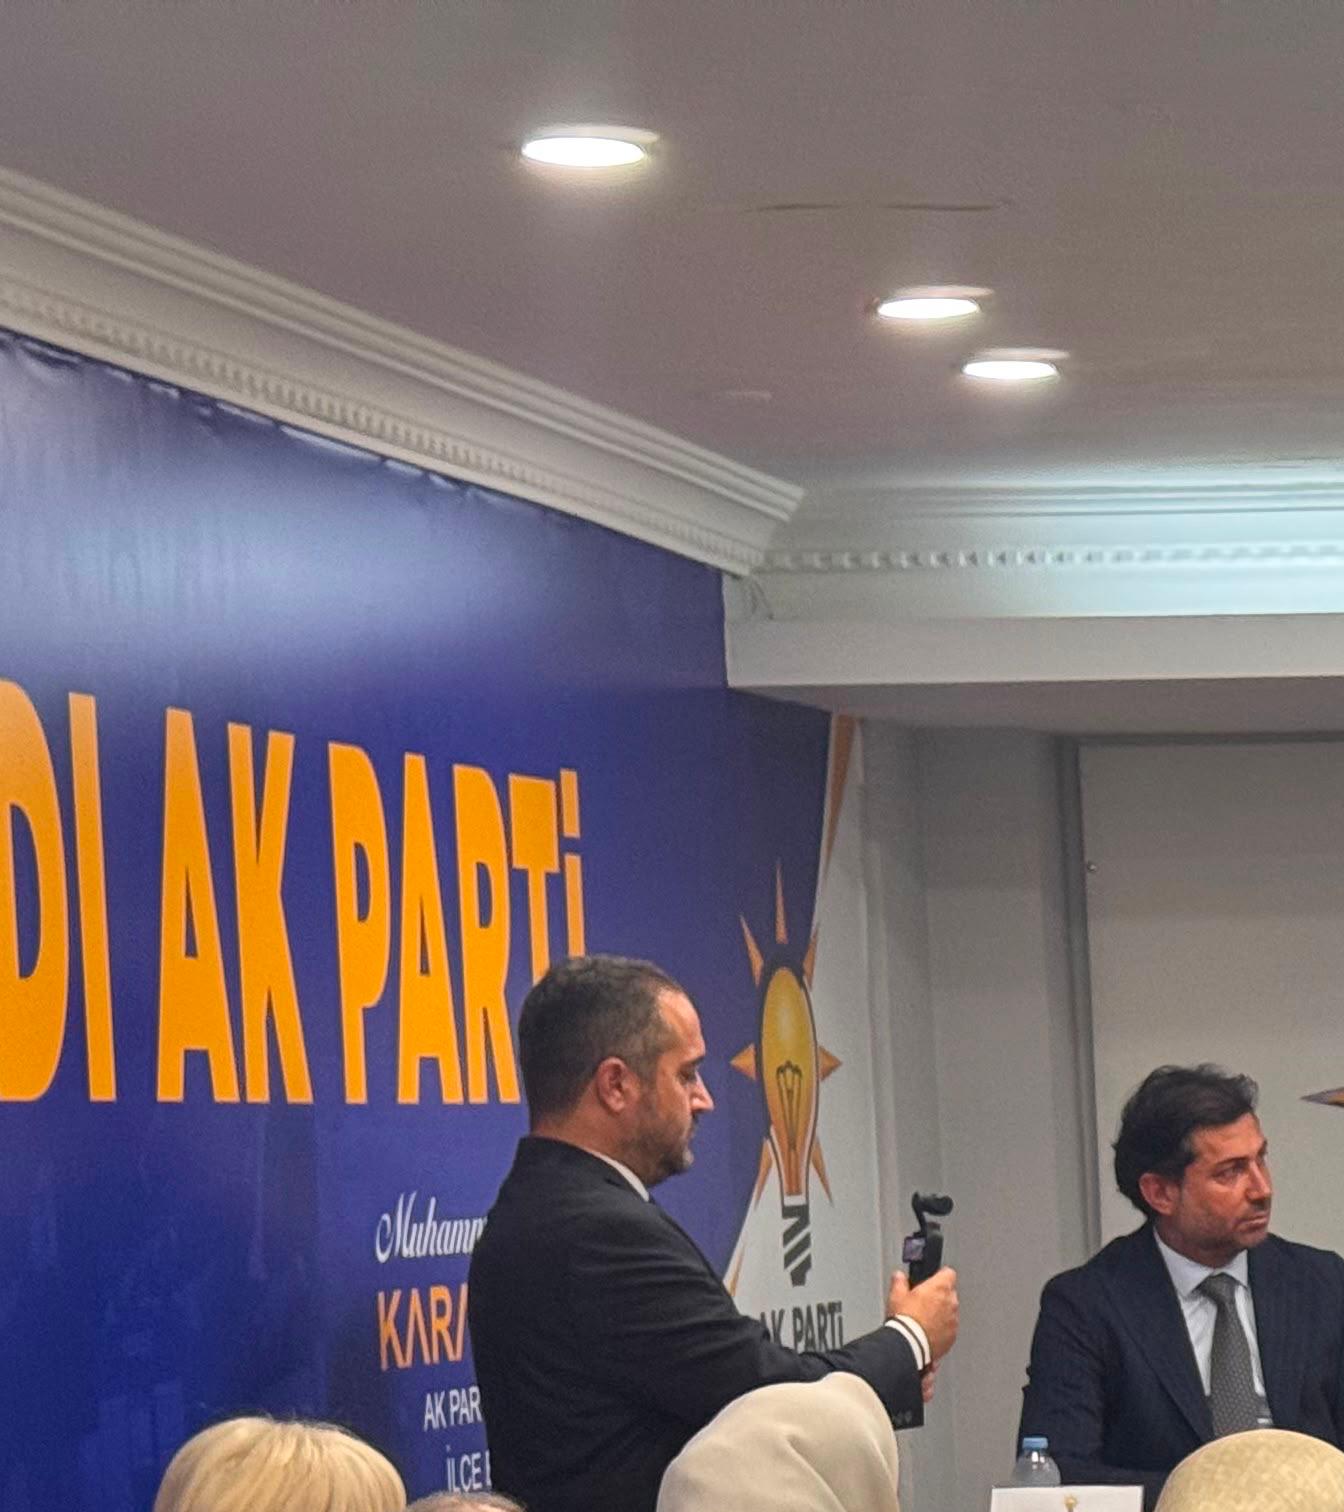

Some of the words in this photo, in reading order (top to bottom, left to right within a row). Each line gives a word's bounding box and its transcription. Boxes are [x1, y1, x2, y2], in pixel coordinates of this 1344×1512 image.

[157, 706, 313, 1104] AK
[328, 741, 586, 1104] PARTİ
[423, 1391, 447, 1432] AK
[449, 1385, 483, 1427] PAR
